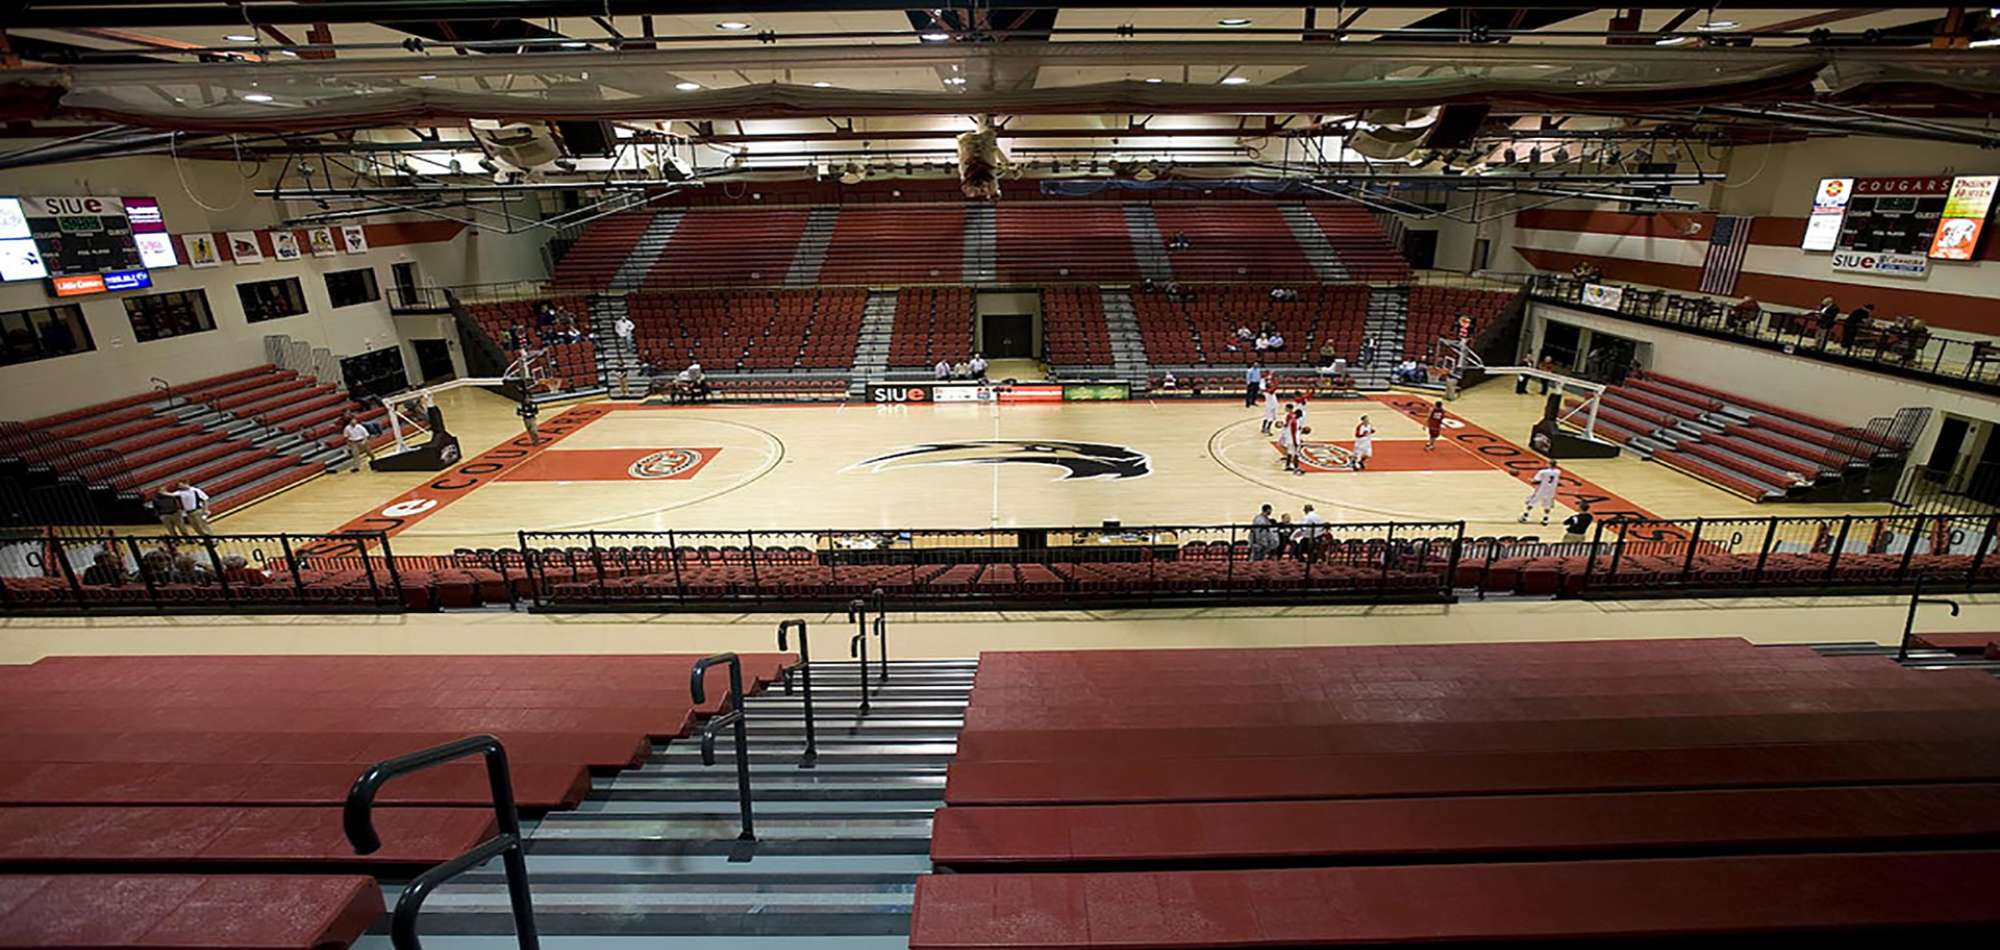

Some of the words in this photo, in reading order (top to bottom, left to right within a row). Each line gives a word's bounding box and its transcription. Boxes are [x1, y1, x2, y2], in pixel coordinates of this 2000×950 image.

[1857, 180, 1950, 191] COUGARS
[46, 198, 103, 215] SIUe
[1832, 254, 1876, 269] SIUe
[874, 388, 925, 402] SIUe
[430, 409, 602, 491] COUGARS
